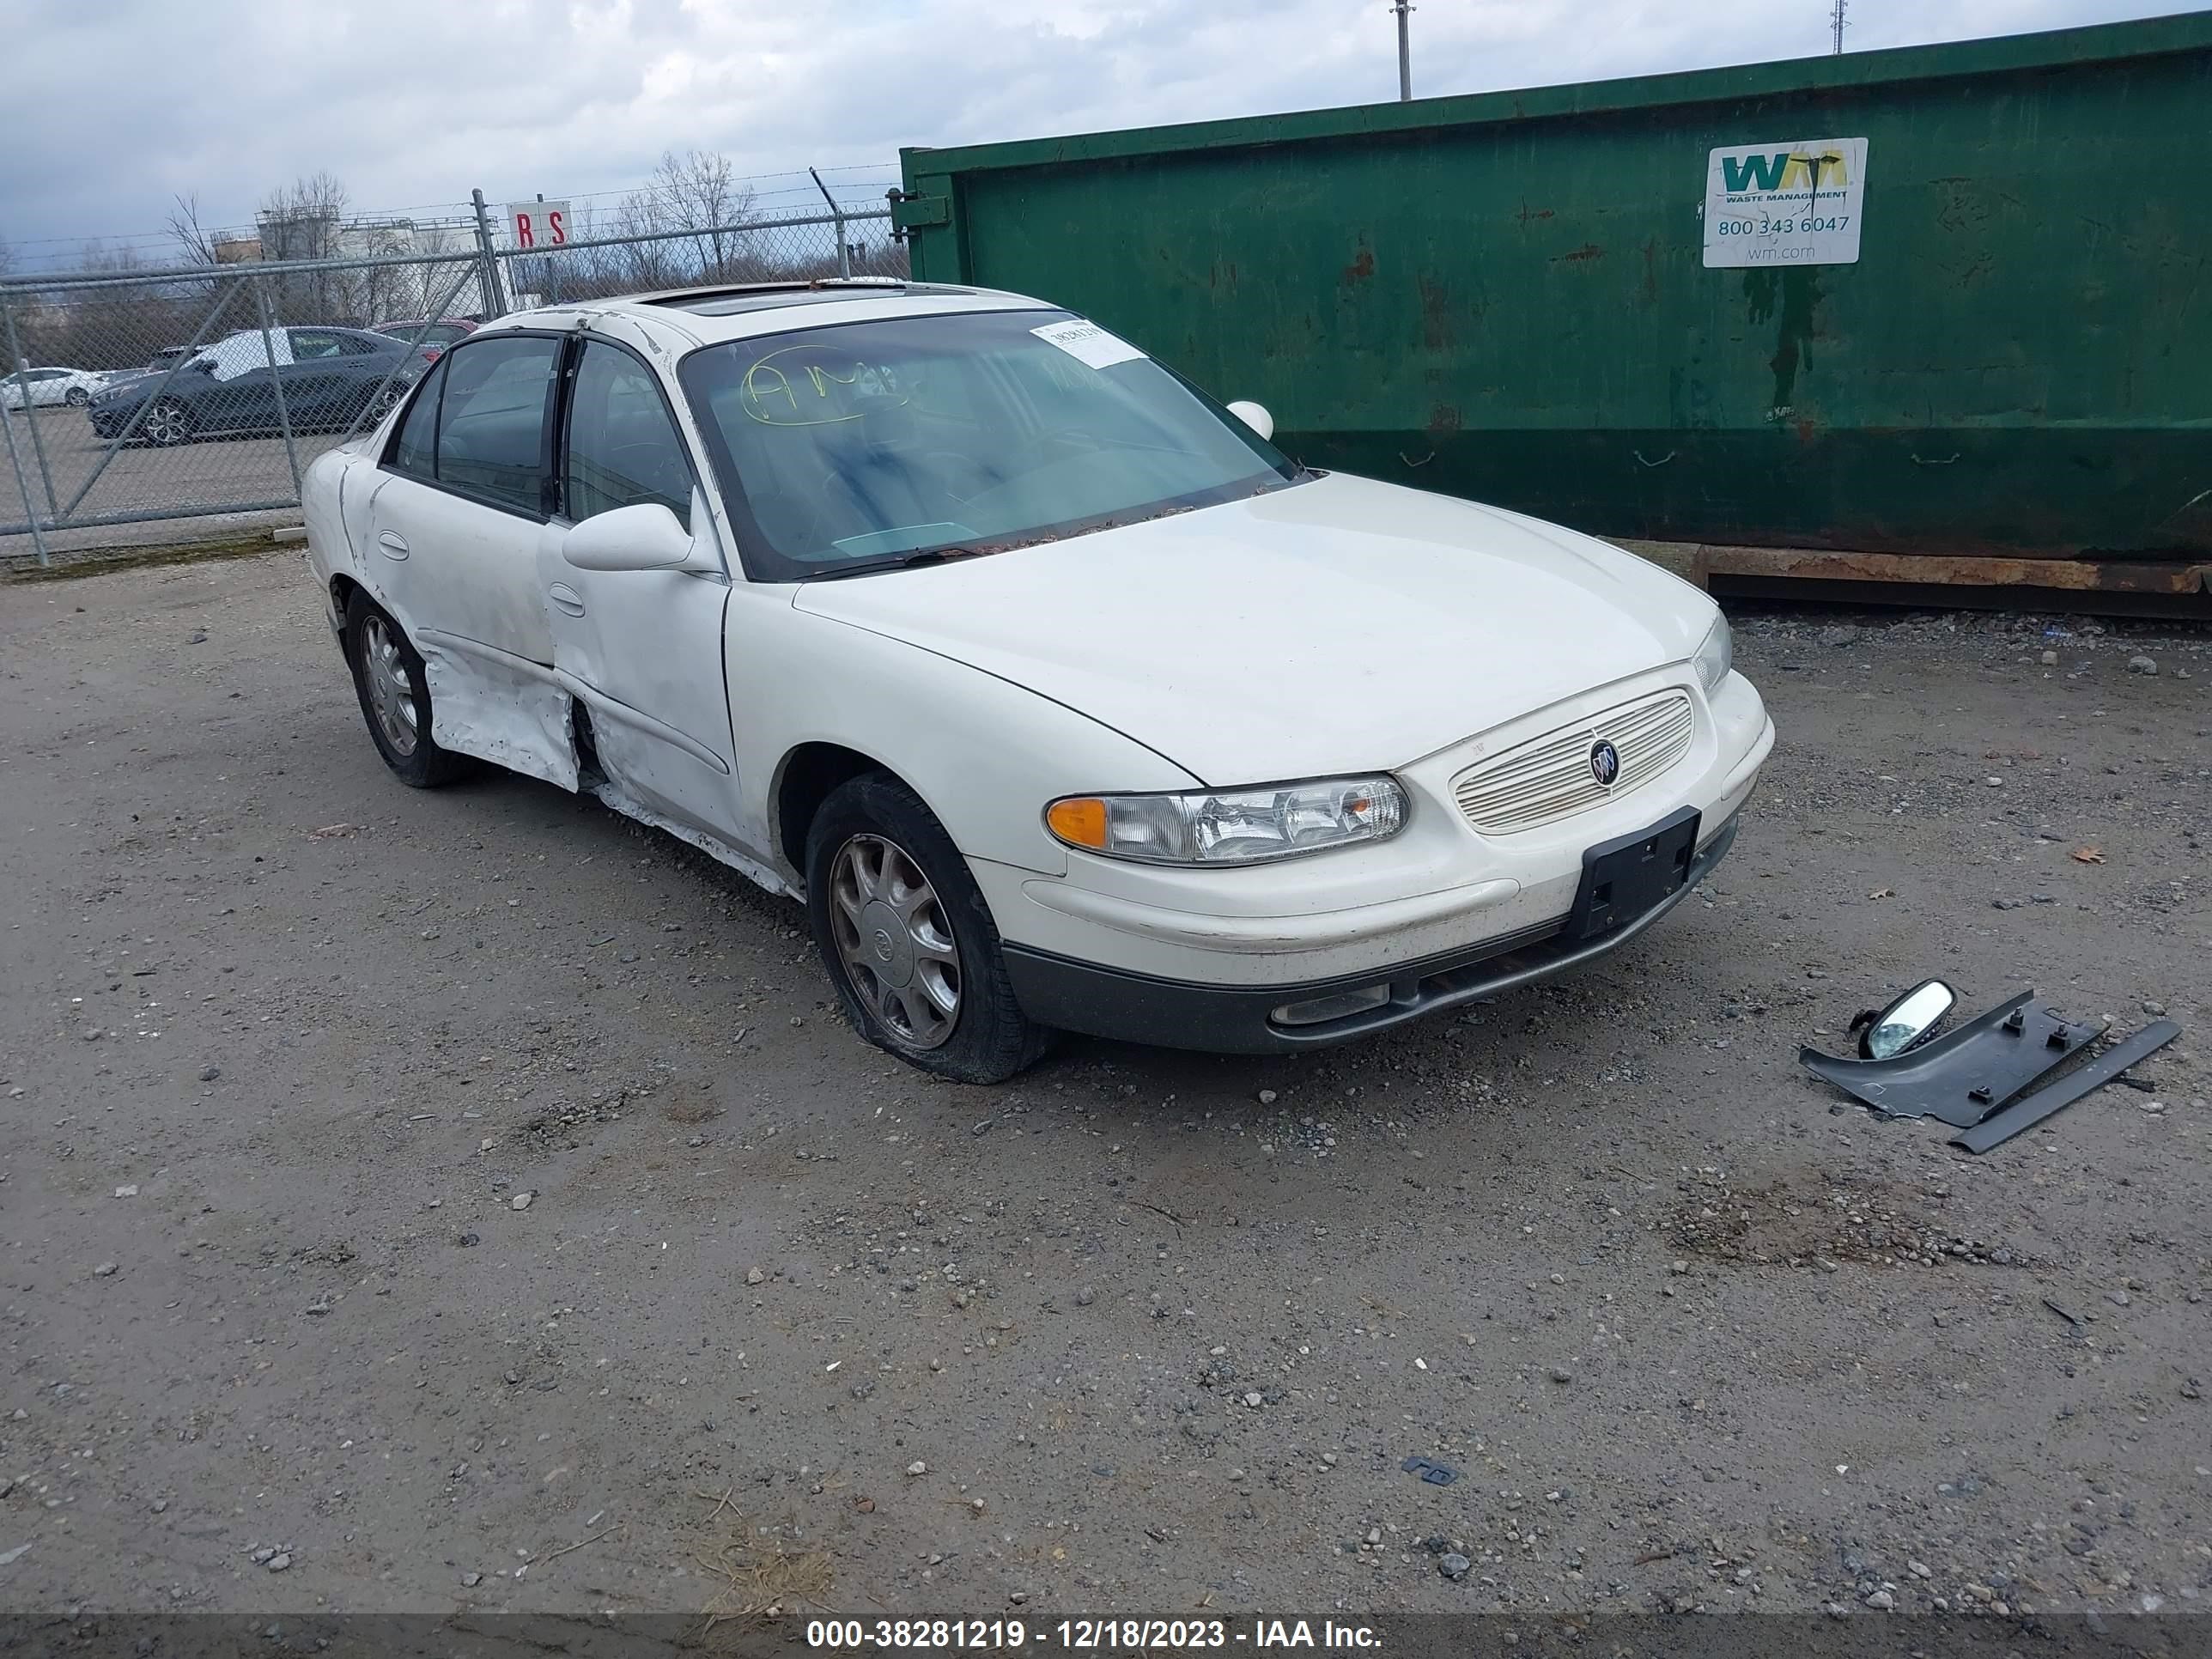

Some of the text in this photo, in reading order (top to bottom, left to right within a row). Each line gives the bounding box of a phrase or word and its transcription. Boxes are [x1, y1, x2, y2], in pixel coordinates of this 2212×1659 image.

[517, 211, 565, 248] R S
[1718, 216, 1850, 236] 800 343 6047
[1747, 246, 1815, 260] wm.com
